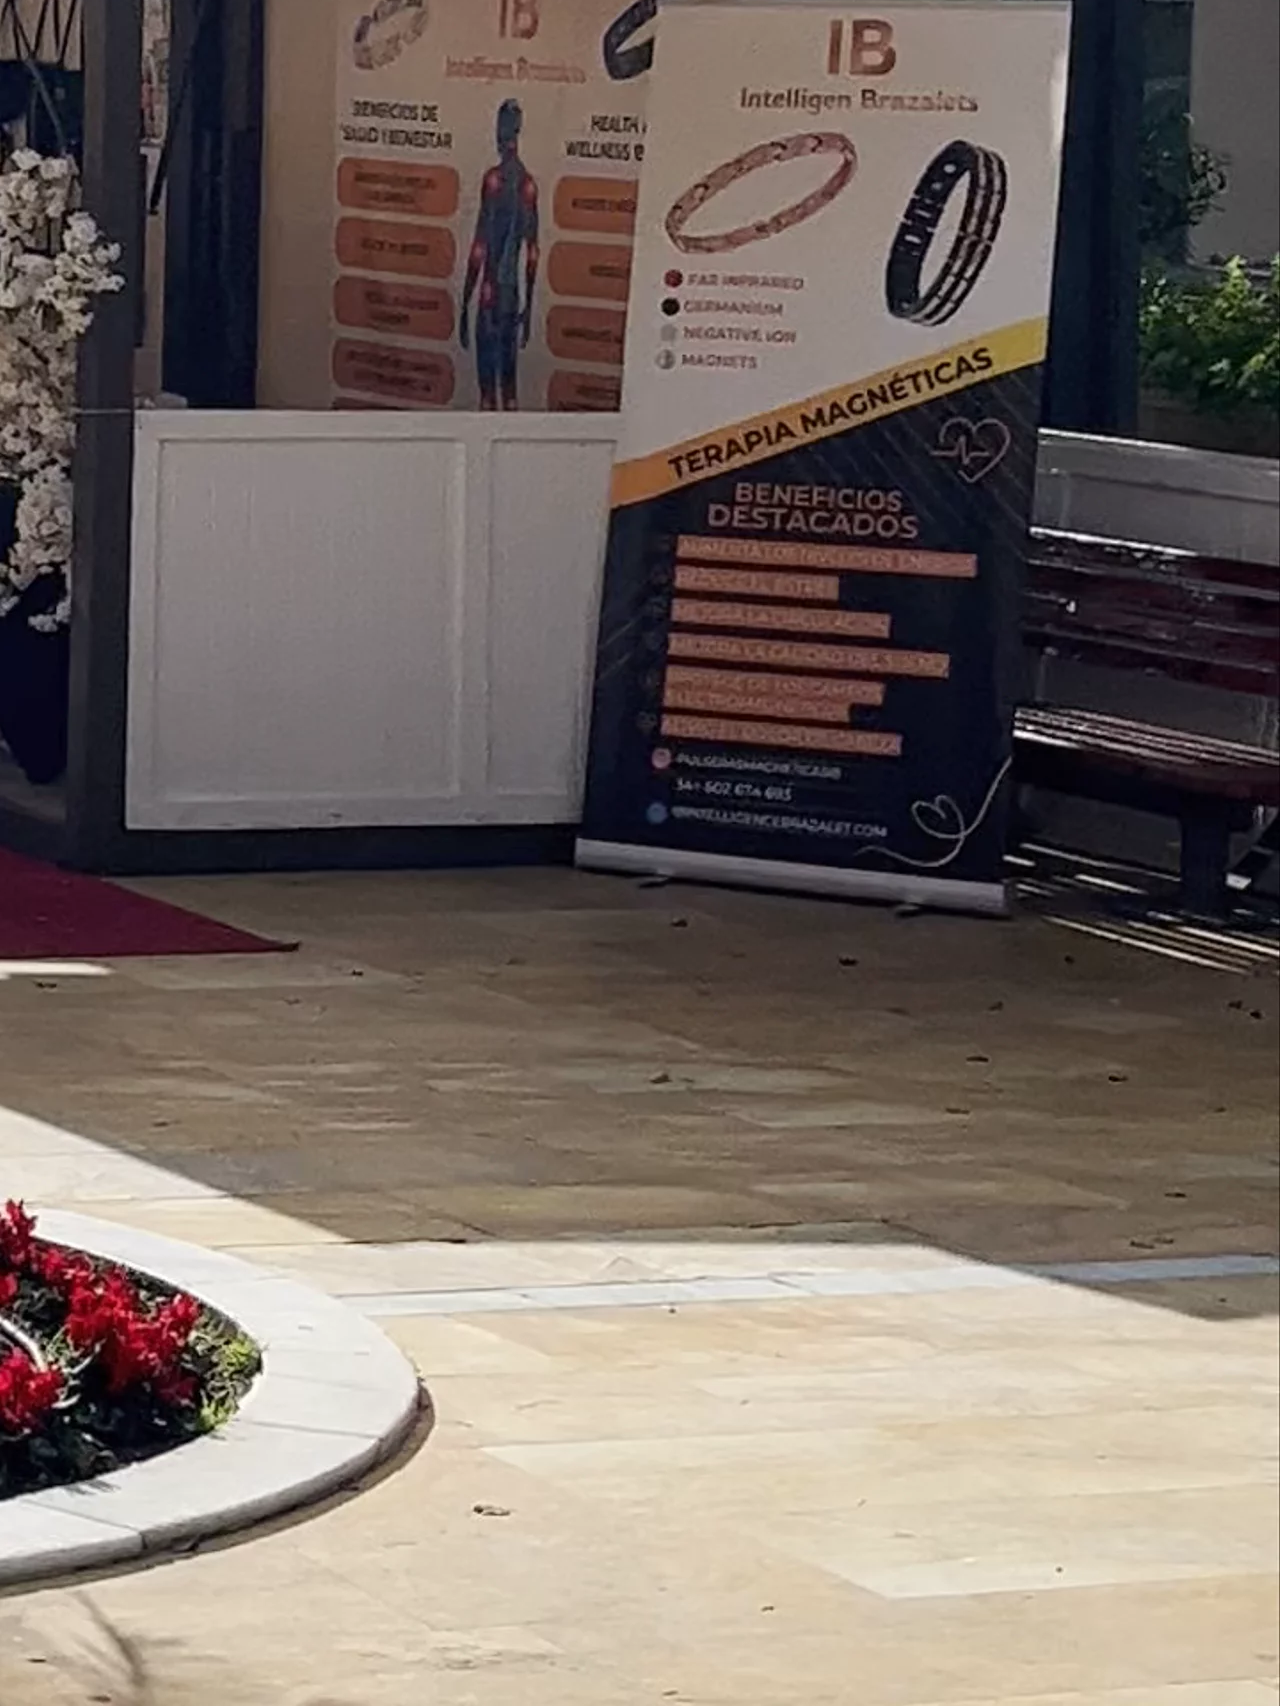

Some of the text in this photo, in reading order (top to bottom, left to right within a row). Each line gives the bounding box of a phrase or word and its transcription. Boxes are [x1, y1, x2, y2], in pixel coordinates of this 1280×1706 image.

[828, 19, 897, 76] IB
[740, 88, 979, 115] Intelligen Brazalets
[683, 300, 783, 317] GERMANIUM
[667, 346, 994, 480] TERAPIA MAGNÉTICAS
[734, 483, 904, 512] BENEFICIOS
[707, 504, 920, 540] DESTACADOS
